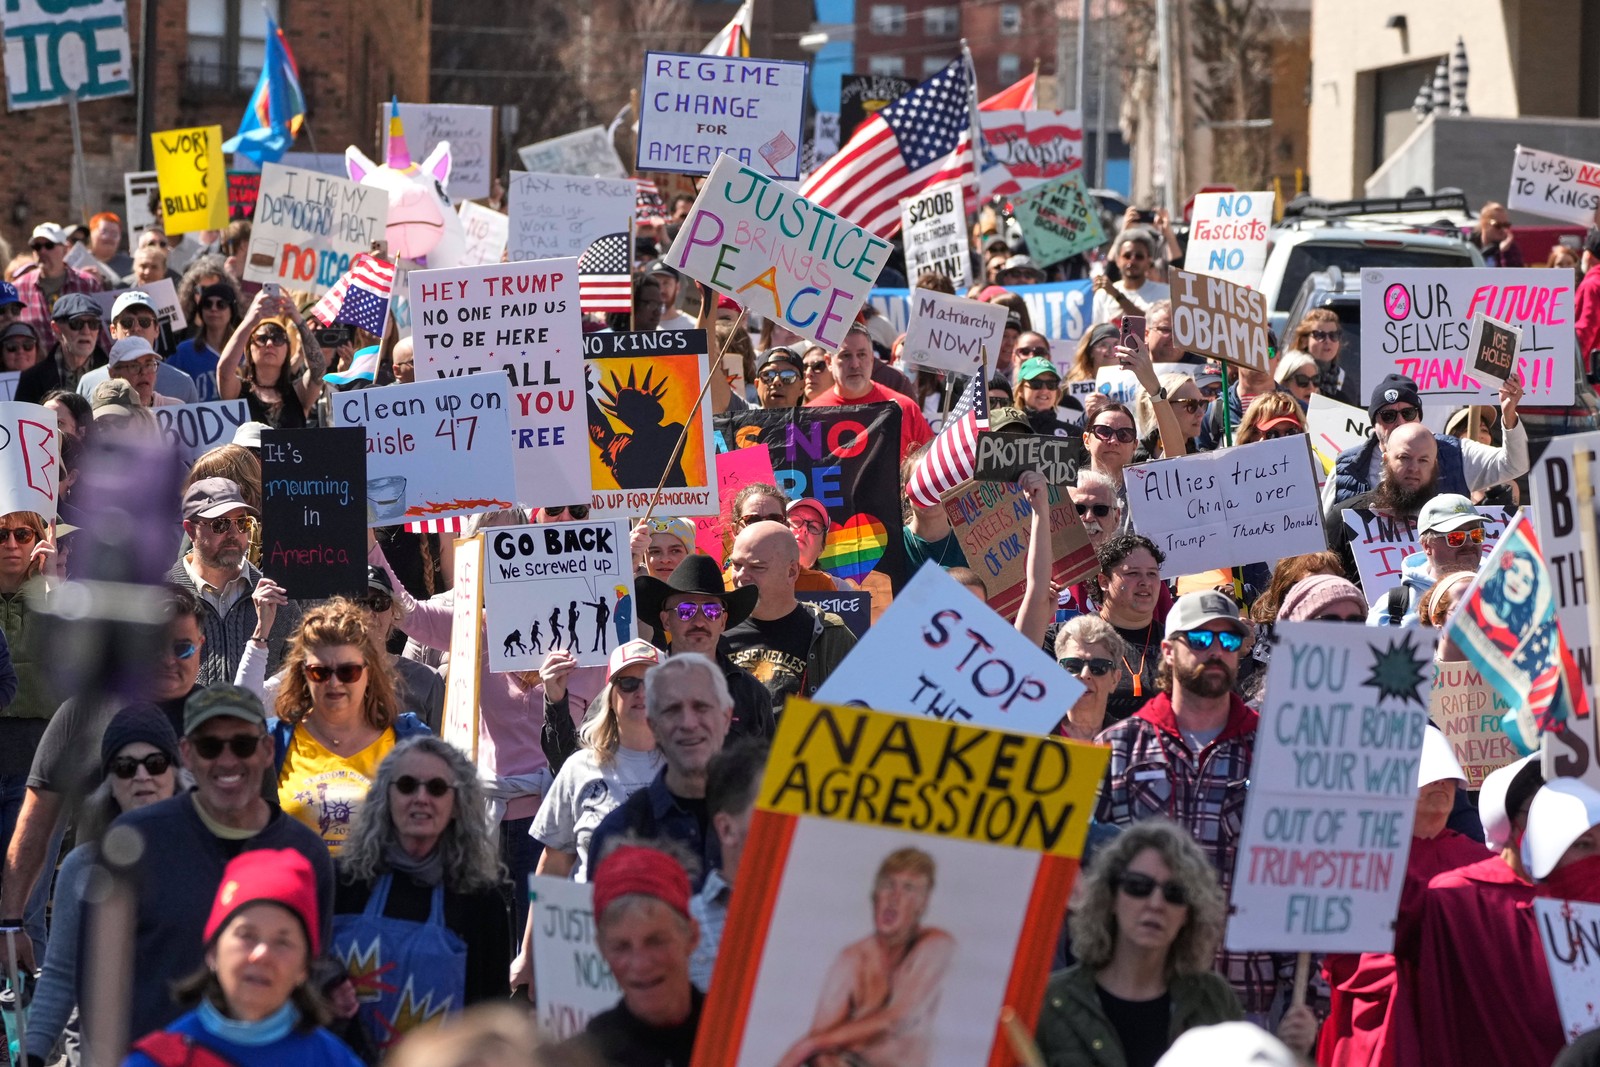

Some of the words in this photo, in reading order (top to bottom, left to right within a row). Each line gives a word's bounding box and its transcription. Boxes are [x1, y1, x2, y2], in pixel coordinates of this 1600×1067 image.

[4, 15, 131, 103] ICE
[656, 59, 780, 86] REGIME
[654, 92, 760, 119] CHANGE
[696, 123, 727, 135] FOR
[992, 130, 1076, 169] People
[284, 171, 298, 199] I
[341, 185, 368, 213] MY
[1516, 177, 1535, 196] TO
[909, 191, 954, 226] $200B
[1072, 203, 1088, 218] TO
[1217, 194, 1252, 217] NO
[724, 167, 888, 283] JUSTICE
[913, 222, 957, 246] HEALTHCARE
[1033, 215, 1077, 242] BOARD
[1193, 218, 1267, 241] Fascists
[930, 245, 947, 260] WAR
[1208, 248, 1244, 271] NO
[421, 280, 468, 303] HEY
[483, 273, 564, 297] TRUMP
[678, 209, 854, 349] PEACE
[423, 308, 448, 326] NO
[457, 306, 491, 322] ONE
[501, 303, 537, 318] PAID
[544, 301, 566, 313] US
[1177, 272, 1199, 305] I
[1207, 278, 1263, 325] MISS
[1384, 283, 1452, 321] OUR
[1466, 285, 1570, 326] FUTURE
[919, 298, 996, 338] Matriarchy
[424, 332, 453, 349] TO
[463, 331, 485, 347] BE
[496, 328, 549, 346] HERE
[613, 331, 688, 353] KINGS
[928, 329, 982, 363] NOW!
[1173, 305, 1270, 370] OBAMA
[1383, 321, 1469, 354] SELVES
[1512, 325, 1554, 352] LL
[1492, 331, 1508, 351] ICE
[1481, 345, 1512, 369] HOLES
[502, 361, 560, 388] ALL
[343, 392, 425, 424] Clean
[435, 394, 461, 418] up
[470, 392, 501, 410] on
[517, 390, 574, 417] YOU
[156, 401, 247, 449] BODY
[366, 427, 416, 455] aisle
[434, 416, 478, 451] 47
[264, 443, 303, 464] It's
[785, 420, 869, 463] NO
[976, 436, 1069, 473] PROTECT
[266, 476, 349, 505] mourning
[1145, 469, 1215, 502] Allies
[1232, 455, 1290, 485] trust
[607, 493, 624, 509] UP
[626, 492, 650, 509] FOR
[650, 491, 710, 506] DEMOCRACY
[1187, 498, 1239, 519] China
[1256, 485, 1296, 504] over
[304, 506, 320, 526] in
[1233, 521, 1276, 538] Thanks
[1283, 511, 1320, 531] Donald!
[494, 531, 534, 560] GO
[544, 528, 613, 555] BACK
[965, 508, 1014, 556] STREETS
[271, 540, 349, 566] America
[500, 563, 520, 579] We
[525, 556, 587, 576] screwed
[594, 559, 612, 576] up
[984, 547, 1002, 576] OF
[999, 533, 1025, 561] OUR
[808, 597, 860, 613] STICE
[760, 649, 806, 673] WELLES
[921, 609, 1046, 712] STOP
[1289, 643, 1350, 693] YOU
[1441, 692, 1487, 715] RAPED
[1275, 702, 1354, 748] CANT
[1360, 706, 1424, 750] BOMB
[1446, 715, 1478, 736] NOT
[1481, 714, 1504, 733] FO
[795, 708, 1070, 797] NAKED
[1455, 737, 1517, 762] NEVER
[1293, 751, 1356, 790] YOUR
[1364, 756, 1418, 794] WAY
[770, 762, 1075, 849] AGRESSION
[1263, 807, 1312, 843] OUT
[1313, 809, 1346, 843] OF
[1357, 809, 1403, 848] THE
[1248, 845, 1395, 892] TRUMPSTEIN
[1285, 893, 1353, 934] FILES
